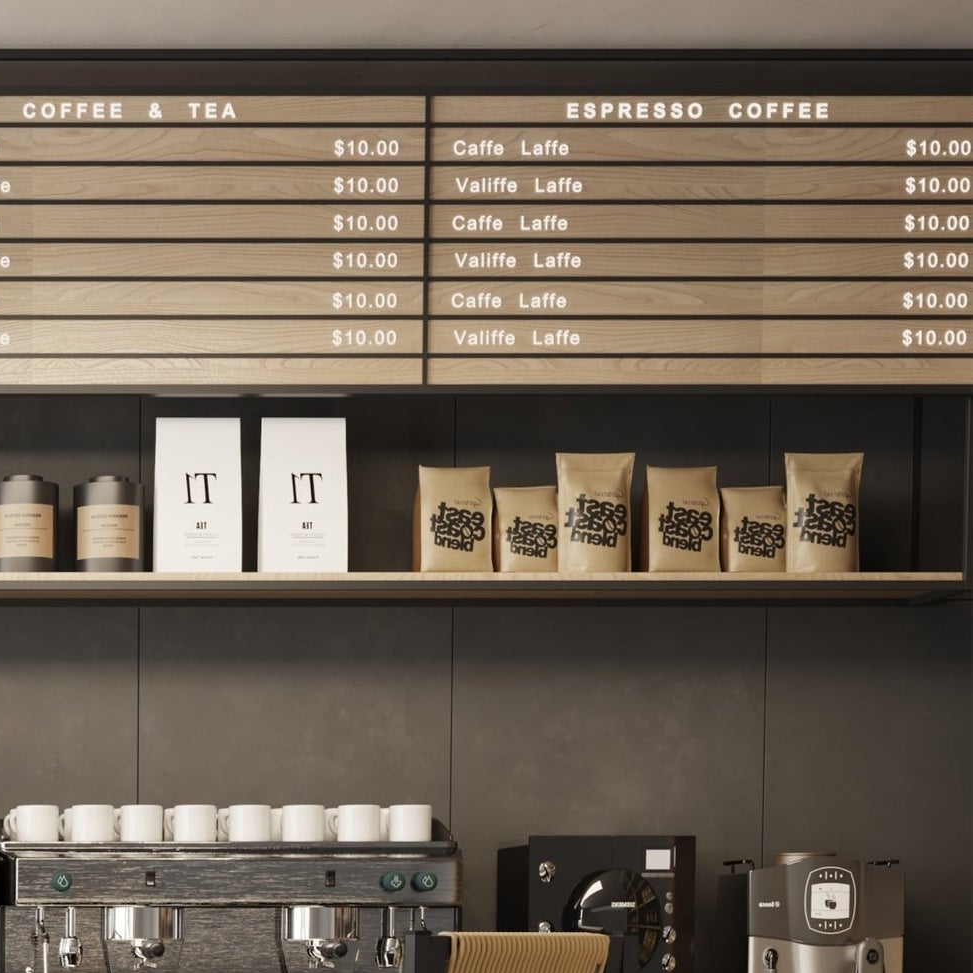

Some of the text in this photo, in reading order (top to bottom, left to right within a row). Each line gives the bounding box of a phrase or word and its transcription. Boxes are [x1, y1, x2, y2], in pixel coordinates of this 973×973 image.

[22, 102, 236, 119] COFFEE & TEA
[566, 102, 829, 119] ESPRESSO COFFEE
[334, 139, 399, 157] $10.00
[453, 140, 569, 156] Caffe Laffe
[906, 139, 972, 157] $10.00
[333, 176, 399, 195] $10.00
[455, 177, 583, 193] Valiffe Laffe
[905, 176, 971, 195] $10.00
[333, 214, 398, 232] $10.00
[452, 215, 568, 231] Caffe Laffe
[904, 214, 970, 232] $10.00
[332, 251, 398, 270] $10.00
[454, 252, 582, 268] Valiffe Laffe
[903, 251, 969, 270] $10.00
[332, 292, 397, 309] $10.00
[451, 292, 567, 309] Caffe Laffe
[902, 291, 968, 310] $10.00
[332, 329, 397, 347] $10.00
[453, 329, 581, 346] Valiffe Laffe
[902, 329, 967, 347] $10.00
